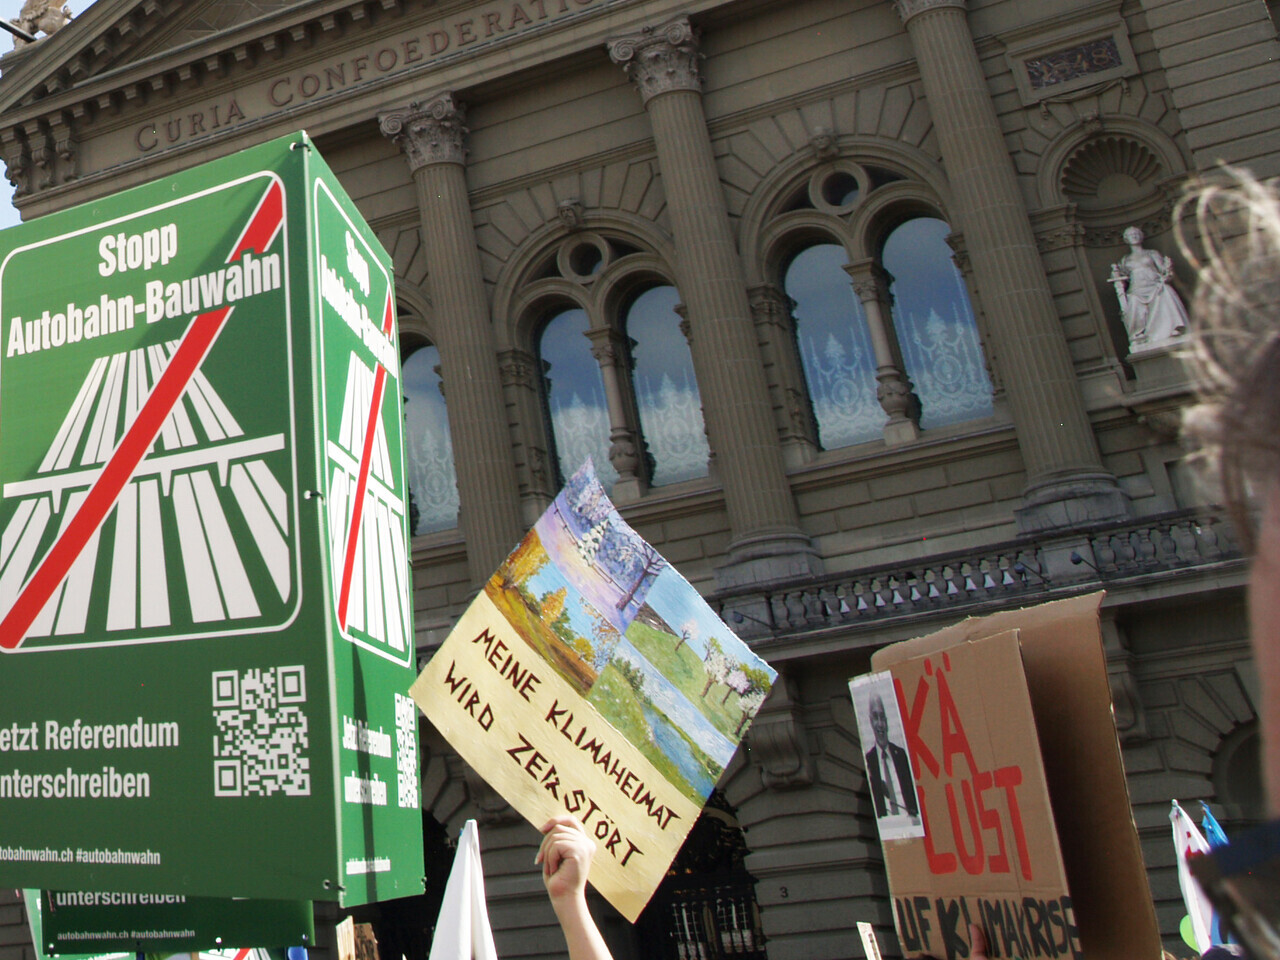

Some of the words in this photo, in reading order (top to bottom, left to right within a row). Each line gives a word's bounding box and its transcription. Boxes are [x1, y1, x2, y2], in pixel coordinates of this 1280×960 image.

[135, 103, 247, 154] CURIA
[98, 223, 178, 277] Stopp
[6, 253, 281, 358] Autobahn-Bauwahn
[444, 660, 494, 731] WIRD
[45, 717, 179, 751] Referendum
[472, 627, 542, 702] MEINE
[545, 699, 681, 831] KLIMAHEIMAT
[917, 765, 1032, 881] LUST
[75, 847, 161, 865] #autobahnwahn
[779, 886, 789, 898] 3
[57, 930, 129, 941] autobahnwahn.ch
[130, 928, 196, 939] #autobahnwahn
